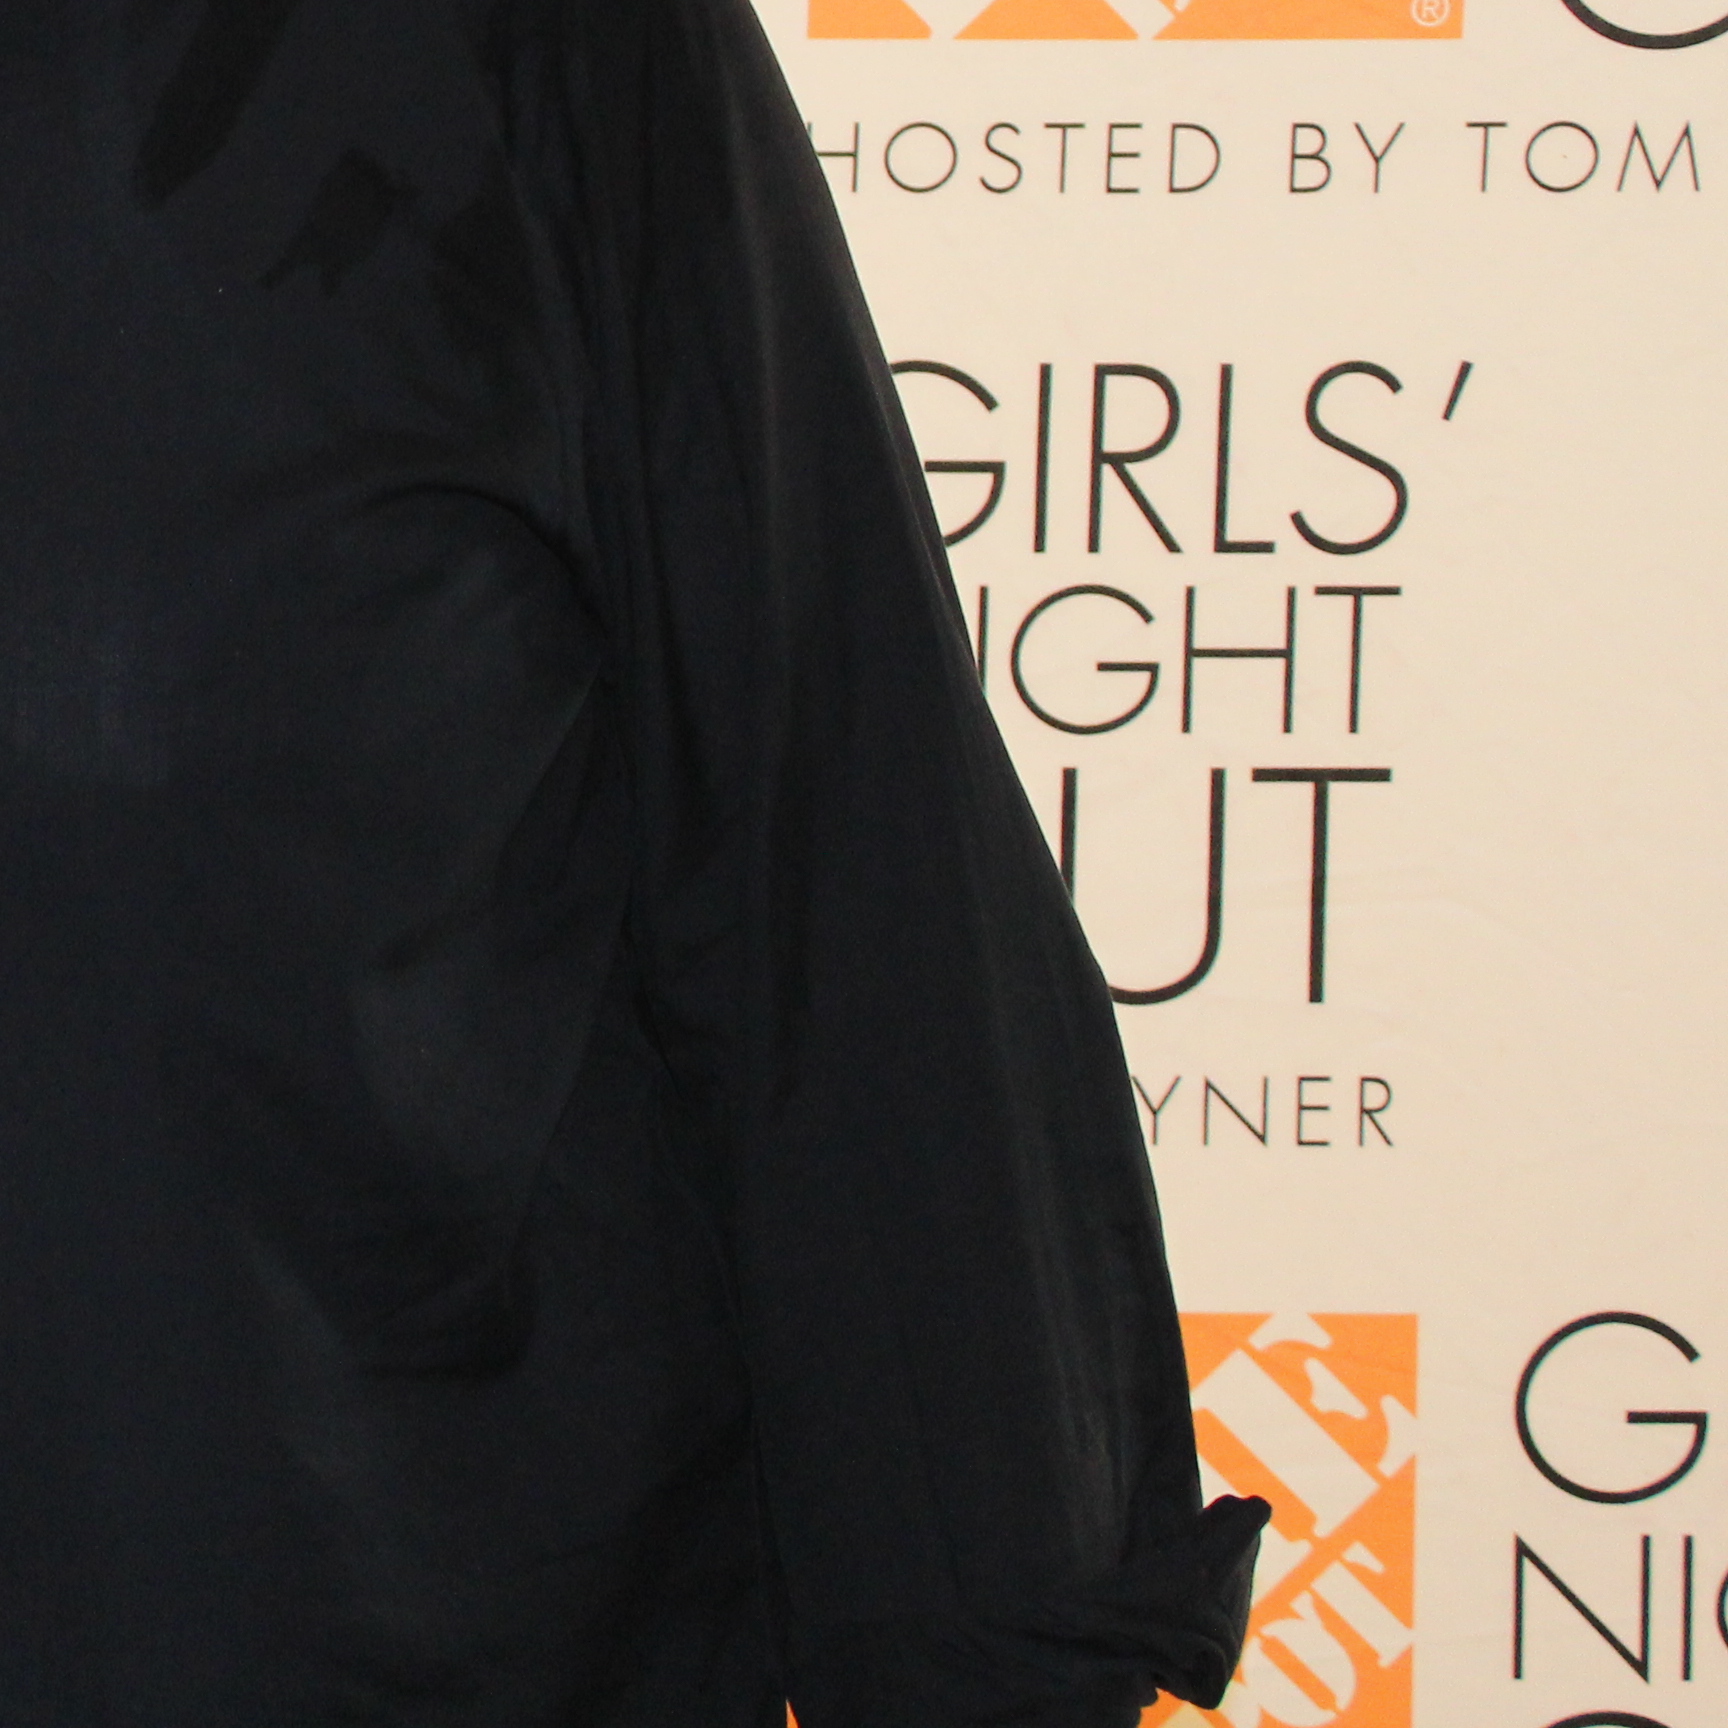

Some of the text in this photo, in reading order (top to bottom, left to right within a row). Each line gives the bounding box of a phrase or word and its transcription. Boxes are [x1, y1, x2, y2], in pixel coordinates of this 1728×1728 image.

[1287, 122, 1406, 194] BY
[1465, 120, 1701, 194] TOM
[974, 583, 1404, 736] IGHT
[1059, 766, 1394, 1007] UT
[1132, 1074, 1395, 1149] YNER
